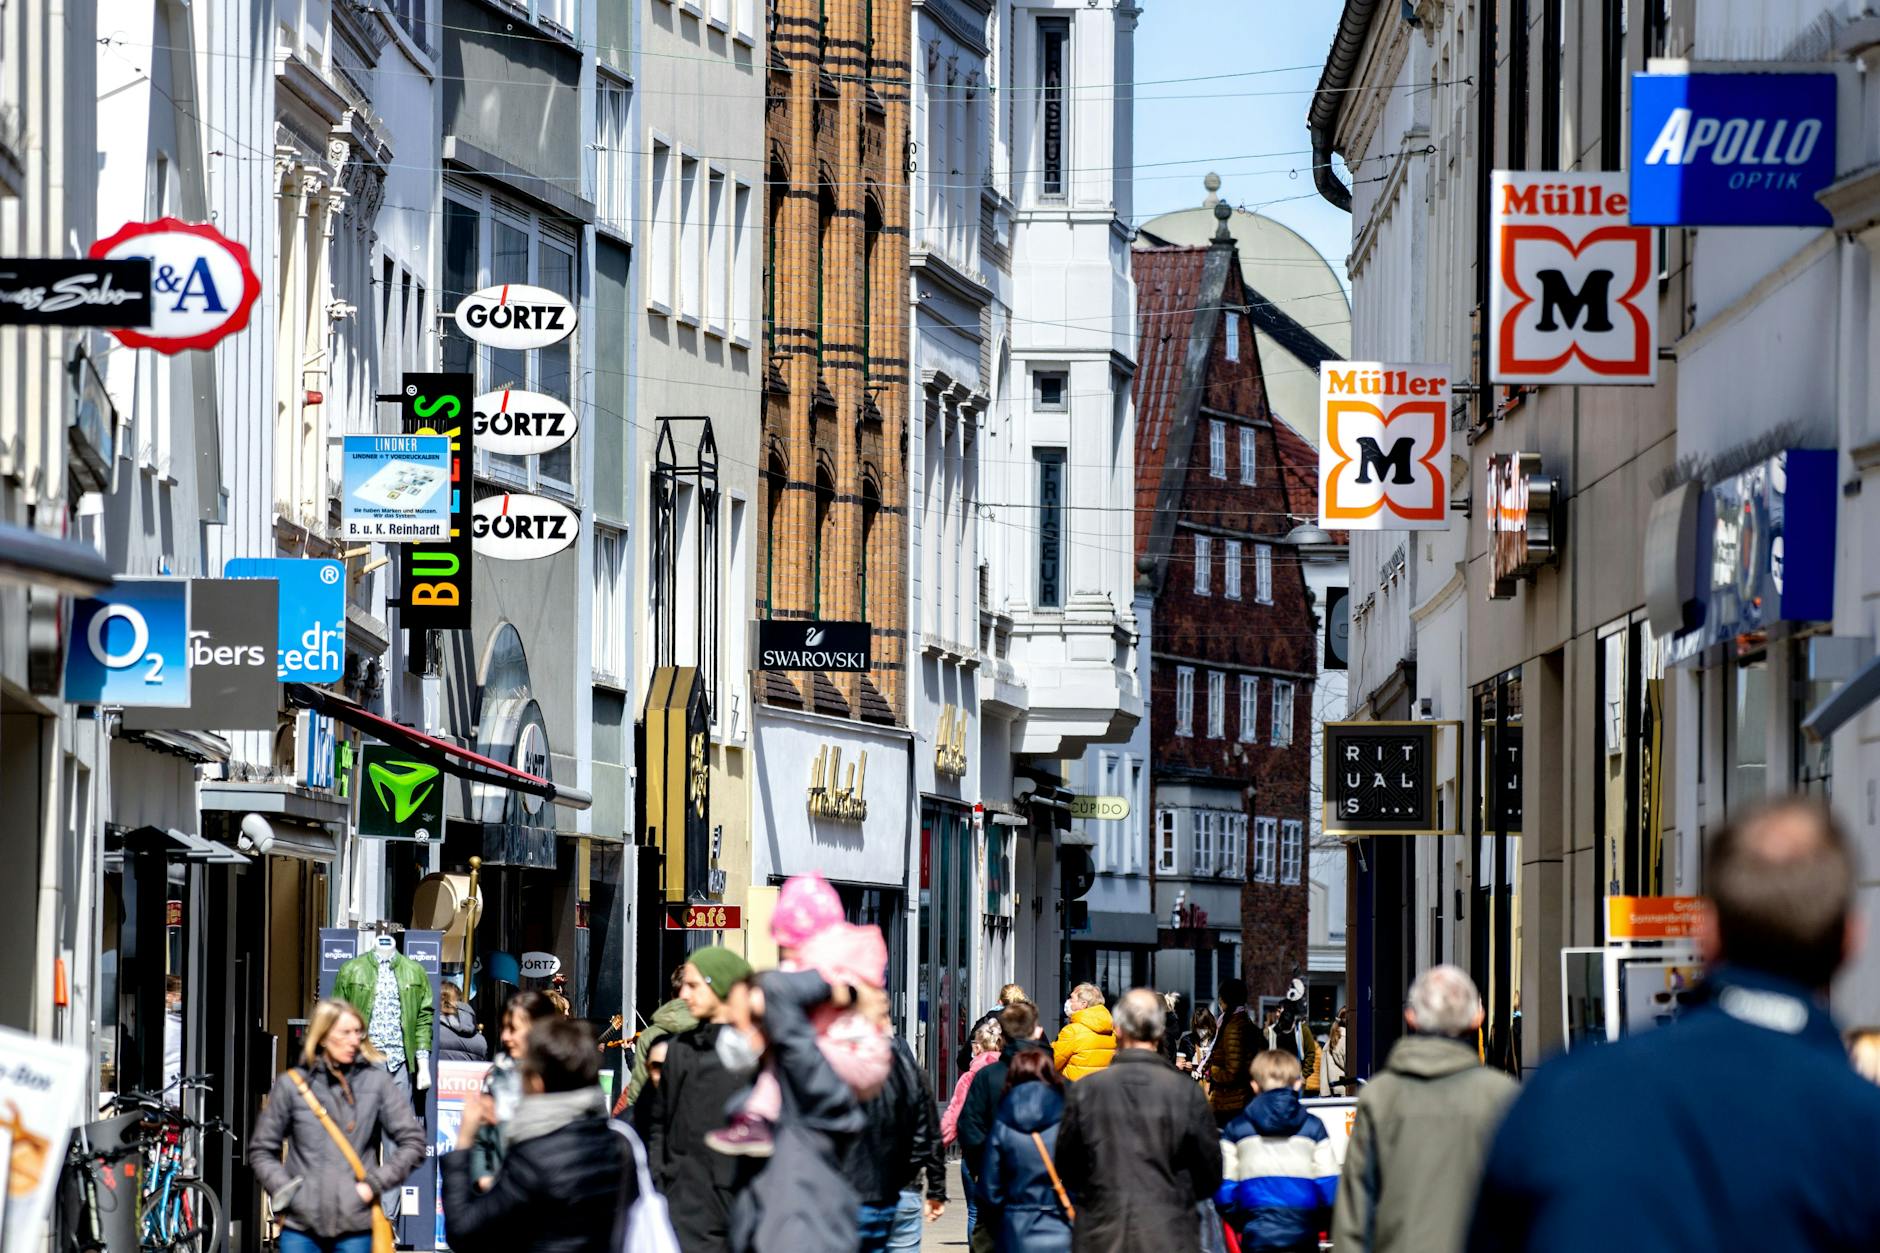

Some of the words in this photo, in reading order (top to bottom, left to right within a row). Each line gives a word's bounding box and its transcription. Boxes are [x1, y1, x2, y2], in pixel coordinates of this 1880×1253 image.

[1644, 107, 1822, 165] APOLLO
[1729, 172, 1802, 190] OPTIK
[1502, 184, 1628, 216] Mülle
[39, 273, 143, 312] Sabo
[126, 256, 228, 313] &A
[1535, 269, 1615, 332] M
[1327, 370, 1447, 396] Müller
[375, 438, 417, 451] LINDNER
[1355, 437, 1416, 484] M
[350, 523, 360, 534] B.
[363, 525, 373, 534] u.
[376, 523, 386, 534] K.
[389, 523, 440, 535] Reinhardt
[1041, 461, 1057, 602] FRISEUR
[190, 640, 265, 669] bers
[763, 650, 865, 669] SWAROVSKI
[682, 907, 727, 927] Café
[325, 952, 353, 960] engbers
[409, 954, 437, 962] engbers
